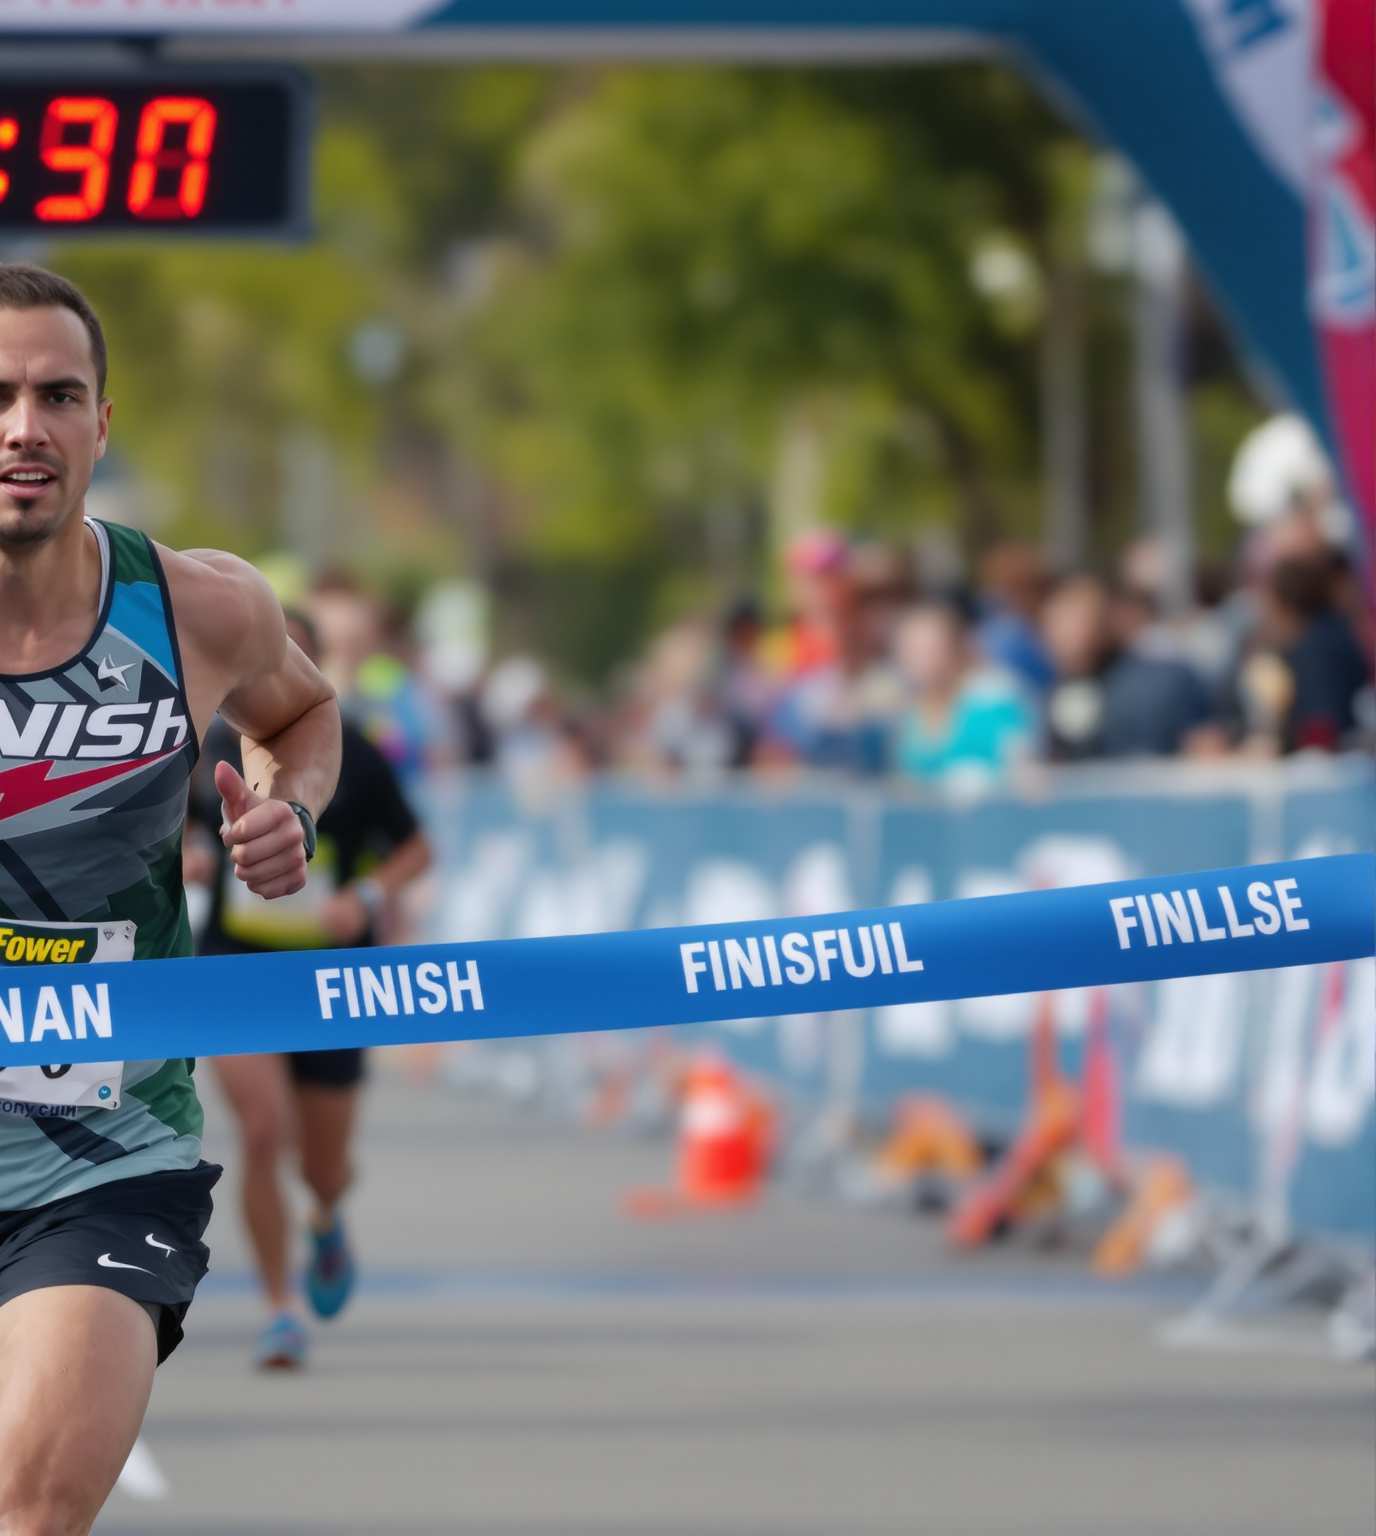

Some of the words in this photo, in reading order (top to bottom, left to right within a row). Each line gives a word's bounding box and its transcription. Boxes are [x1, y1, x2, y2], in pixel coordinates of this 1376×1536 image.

[1109, 878, 1310, 950] FINLLSE
[315, 960, 484, 1019] FINISH
[680, 922, 924, 993] FINISFUIL
